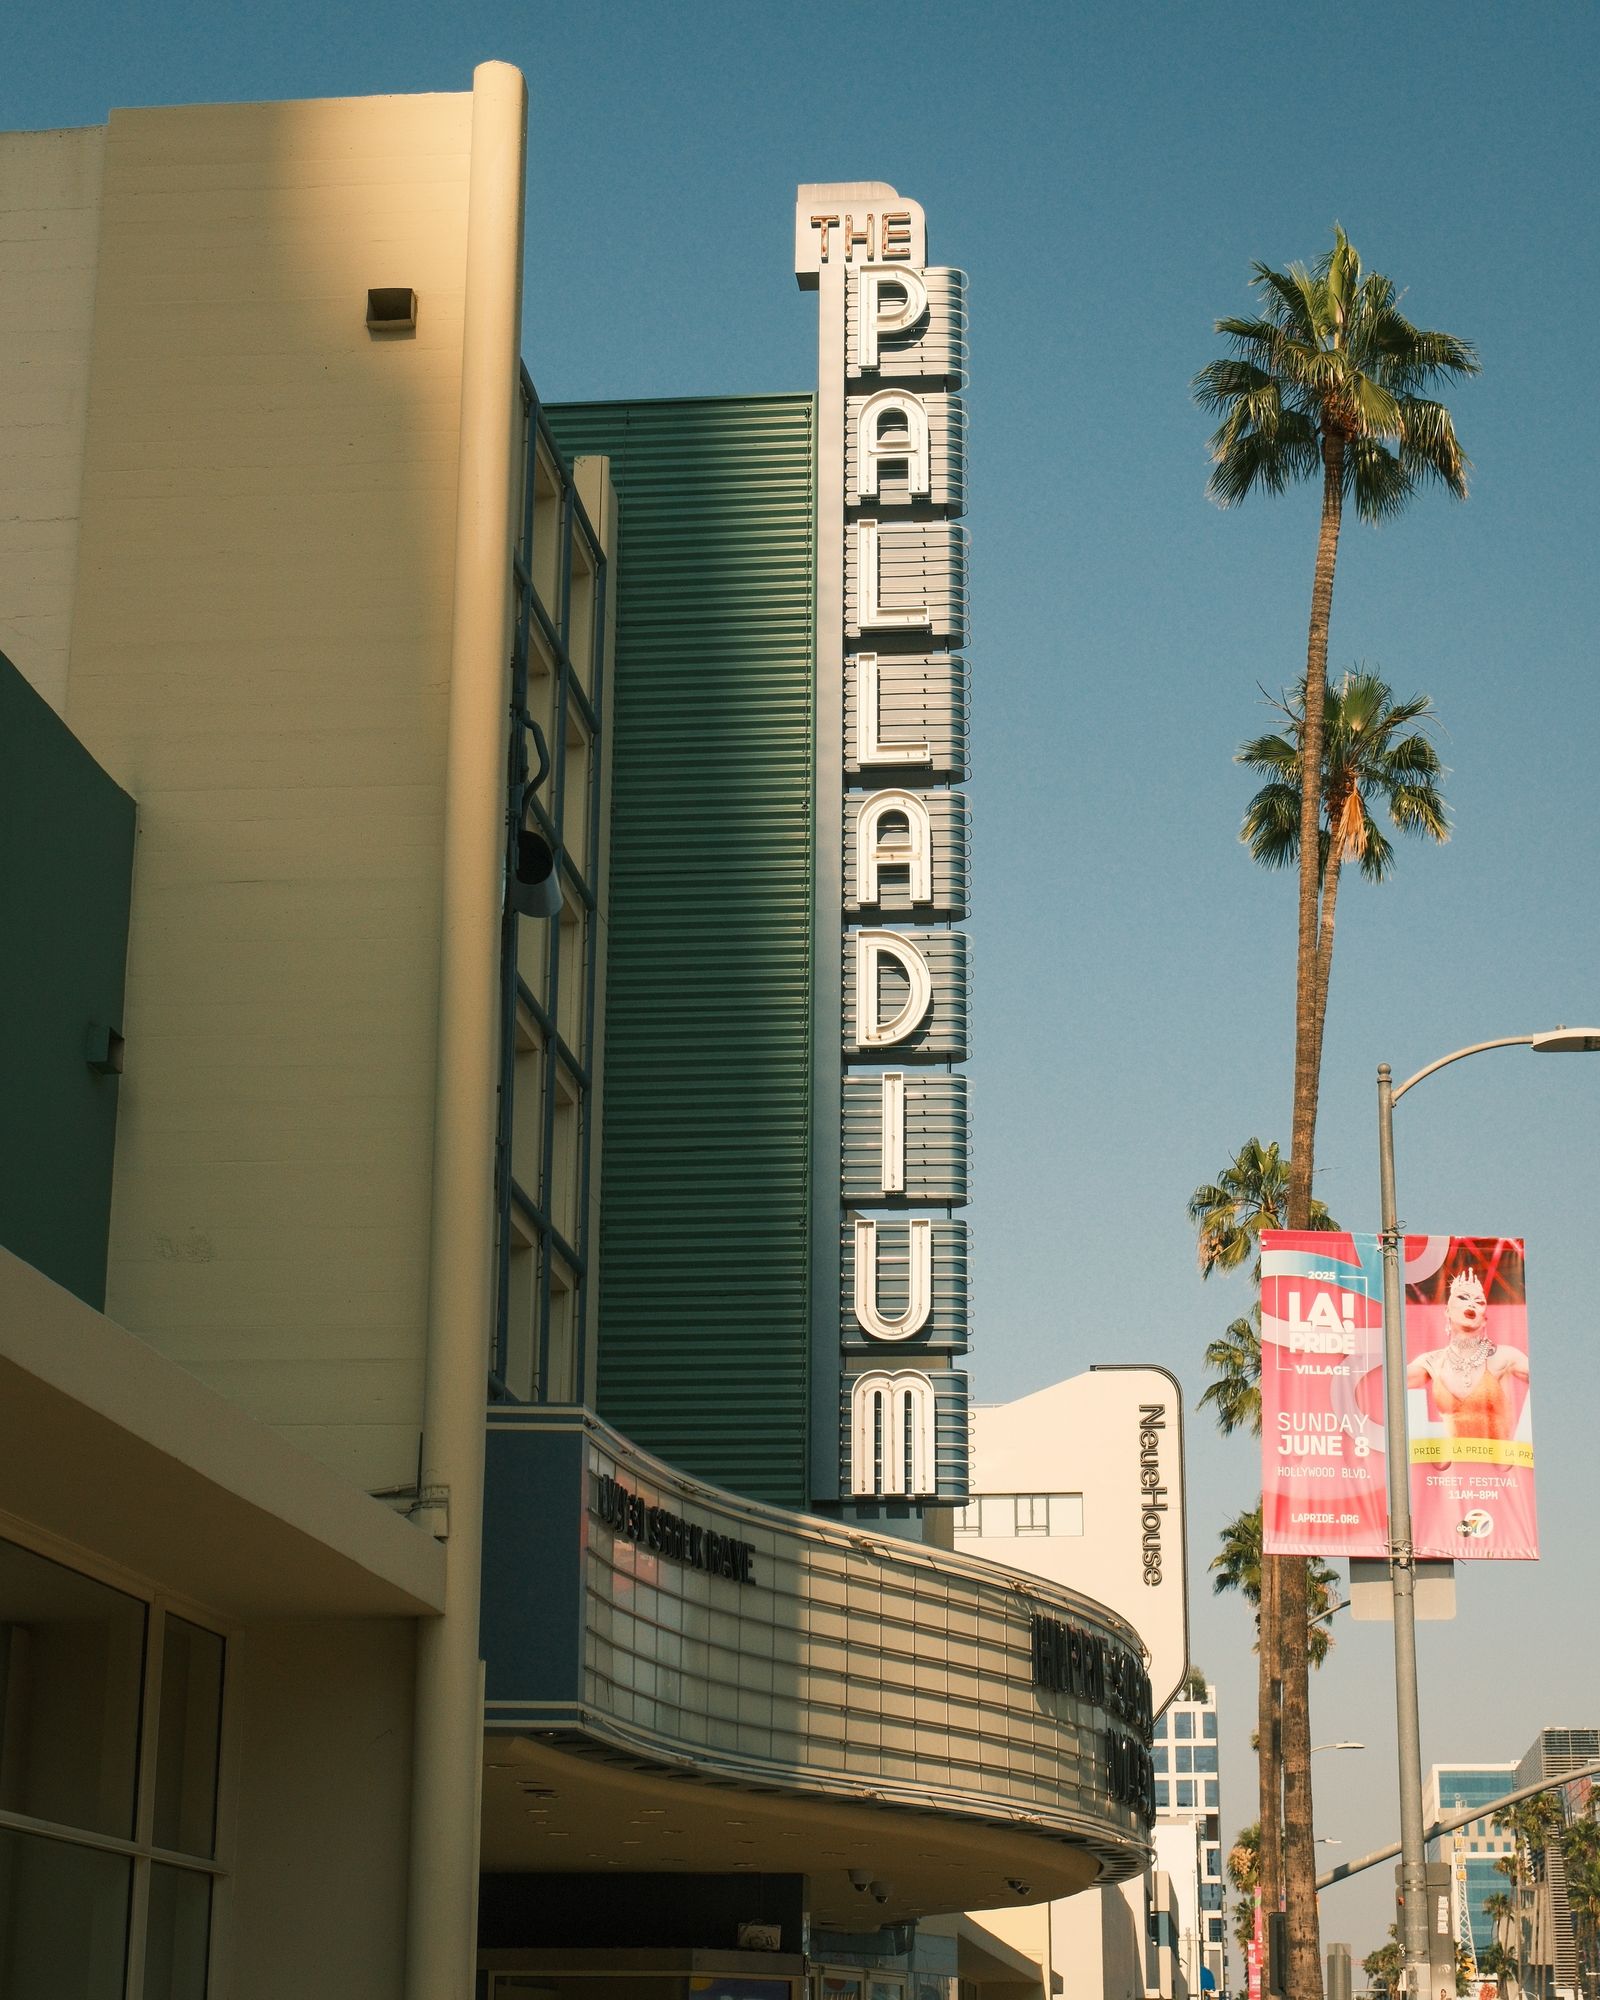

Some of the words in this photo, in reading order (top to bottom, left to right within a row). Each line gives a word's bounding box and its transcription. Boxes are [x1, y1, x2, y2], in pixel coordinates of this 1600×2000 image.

[811, 212, 911, 263] THE
[851, 264, 936, 1495] PALLADIUM
[1307, 1270, 1336, 1281] 2025
[1289, 1332, 1355, 1354] PRIDE
[1296, 1365, 1350, 1376] VILLAGE
[1277, 1412, 1368, 1434] SUNDAY
[1277, 1434, 1343, 1456] JUNE
[1354, 1436, 1370, 1457] 8
[1414, 1446, 1441, 1455] PRIDE
[1453, 1446, 1462, 1454] LA
[1466, 1446, 1494, 1455] PRIDE
[1277, 1466, 1335, 1478] HOLLYWOOD
[1341, 1467, 1371, 1479] BLVD.
[1426, 1476, 1463, 1486] STREET
[1469, 1476, 1519, 1487] FESTIVAL
[1138, 1404, 1168, 1587] NeueHouse
[1291, 1513, 1359, 1524] LAPRIDE.ORG
